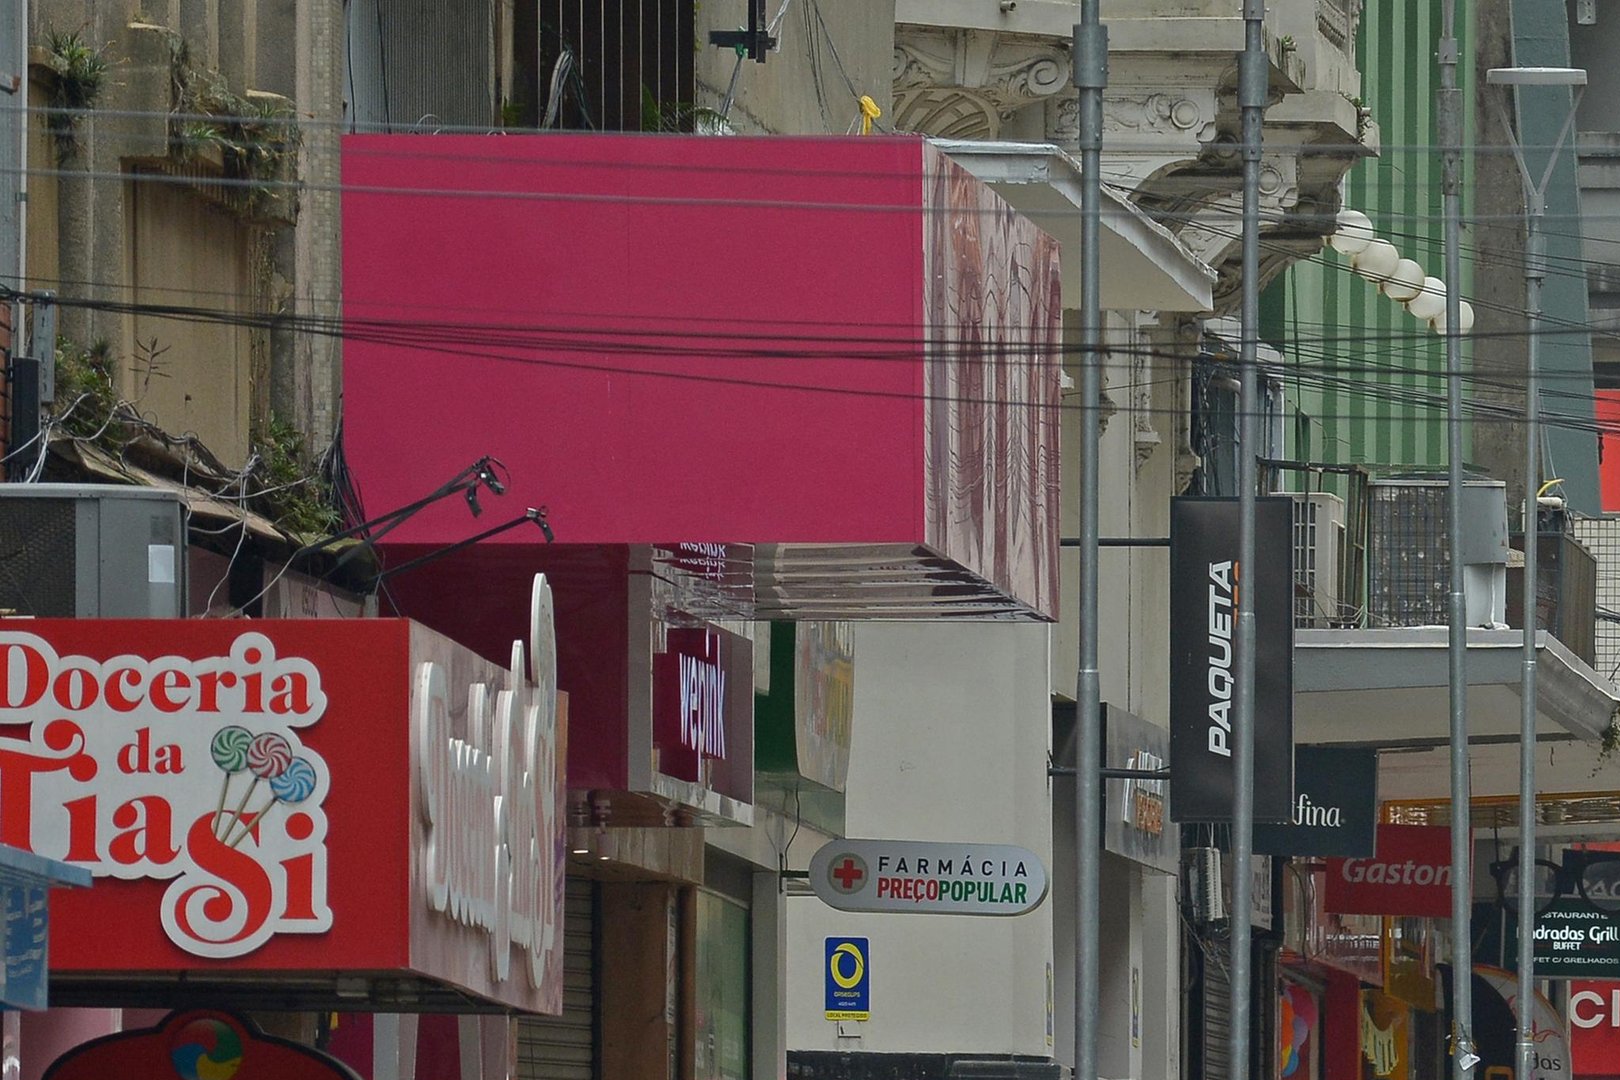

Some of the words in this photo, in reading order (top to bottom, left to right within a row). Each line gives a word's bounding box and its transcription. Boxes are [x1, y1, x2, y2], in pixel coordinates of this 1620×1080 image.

[0, 644, 313, 715] Doceria
[679, 626, 727, 760] wepink
[117, 726, 186, 775] da
[1294, 793, 1341, 827] fina
[174, 810, 319, 945] Si
[878, 855, 1028, 877] FARMÁCIA
[1342, 858, 1453, 886] Gaston
[1553, 942, 1581, 951] BUFFET
[1589, 926, 1619, 944] Grill
